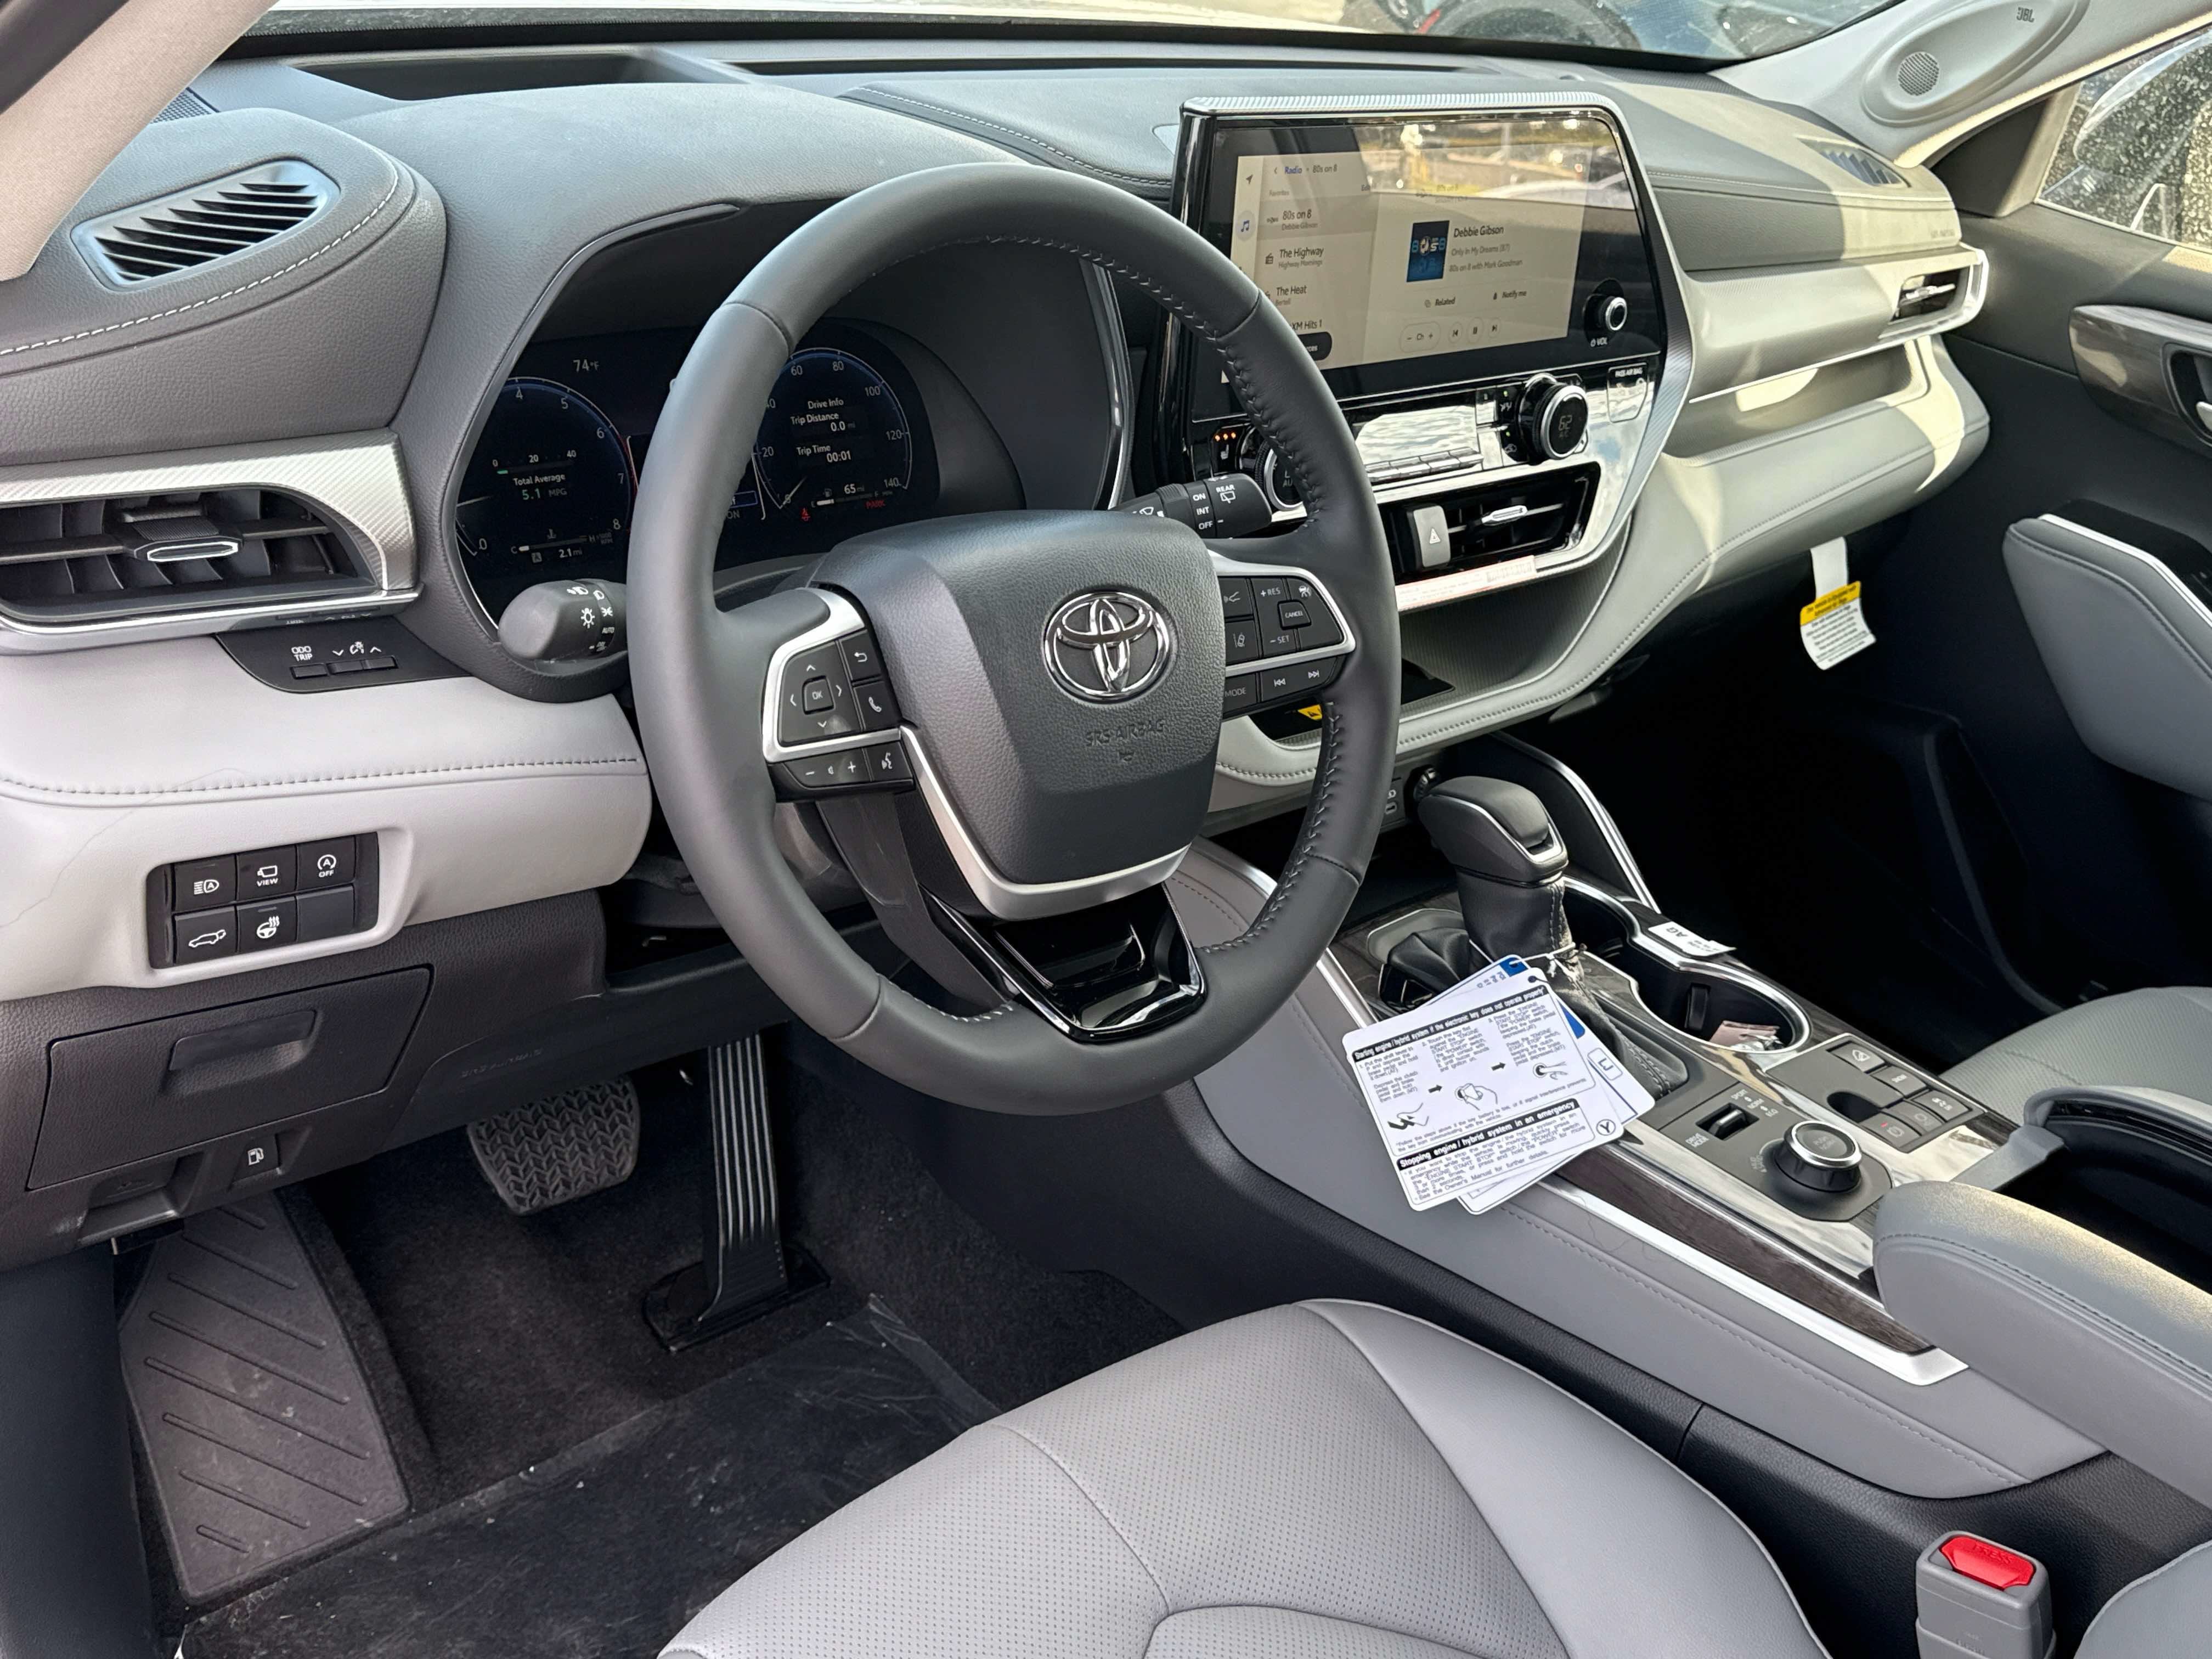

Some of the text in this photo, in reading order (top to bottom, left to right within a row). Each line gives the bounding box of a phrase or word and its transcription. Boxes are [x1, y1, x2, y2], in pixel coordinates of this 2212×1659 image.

[2016, 7, 2035, 22] JBL
[1283, 210, 1295, 220] 80s
[1297, 211, 1306, 219] on
[1307, 208, 1312, 219] 8
[1454, 224, 1504, 238] Debbie Gibson
[1279, 246, 1324, 259] The Highway
[1276, 285, 1307, 296] The Heat
[1435, 296, 1455, 306] Related
[1305, 320, 1317, 330] Hits
[791, 365, 803, 376] 60
[832, 360, 844, 371] 80
[515, 387, 523, 400] 4
[865, 385, 880, 397] 100
[561, 397, 569, 410] 5
[808, 398, 844, 410] Drive Info
[791, 412, 839, 426] Trip Distance
[831, 421, 845, 432] 0.0
[596, 427, 605, 439] 6
[886, 430, 901, 441] 120
[761, 447, 774, 457] 20
[797, 444, 831, 456] Trip Time
[492, 450, 576, 467] 0 20 40
[827, 450, 851, 463] 00:01
[512, 474, 566, 486] Total Average
[617, 472, 624, 484] 7
[884, 477, 900, 488] 140
[522, 488, 567, 500] 5.1 MPG
[844, 483, 856, 494] 65
[1216, 484, 1235, 493] REAR
[1193, 493, 1206, 501] ON
[1196, 506, 1210, 516] INT
[613, 518, 621, 530] 8
[1198, 521, 1214, 531] OFF
[479, 538, 488, 550] 0
[1285, 610, 1304, 618] CANCEL
[291, 646, 312, 654] ODO
[294, 653, 313, 662] TRIP
[812, 690, 823, 700] OK
[1225, 687, 1246, 697] MODE
[256, 878, 279, 887] VIEW
[1599, 1121, 1613, 1134] Y
[1399, 1152, 1432, 1167] Stopping
[1434, 1143, 1457, 1155] engine
[1461, 1131, 1485, 1146] hybrid
[1487, 1123, 1513, 1137] system
[1537, 1101, 1576, 1119] emergency
[1973, 1543, 2012, 1564] PRESS
